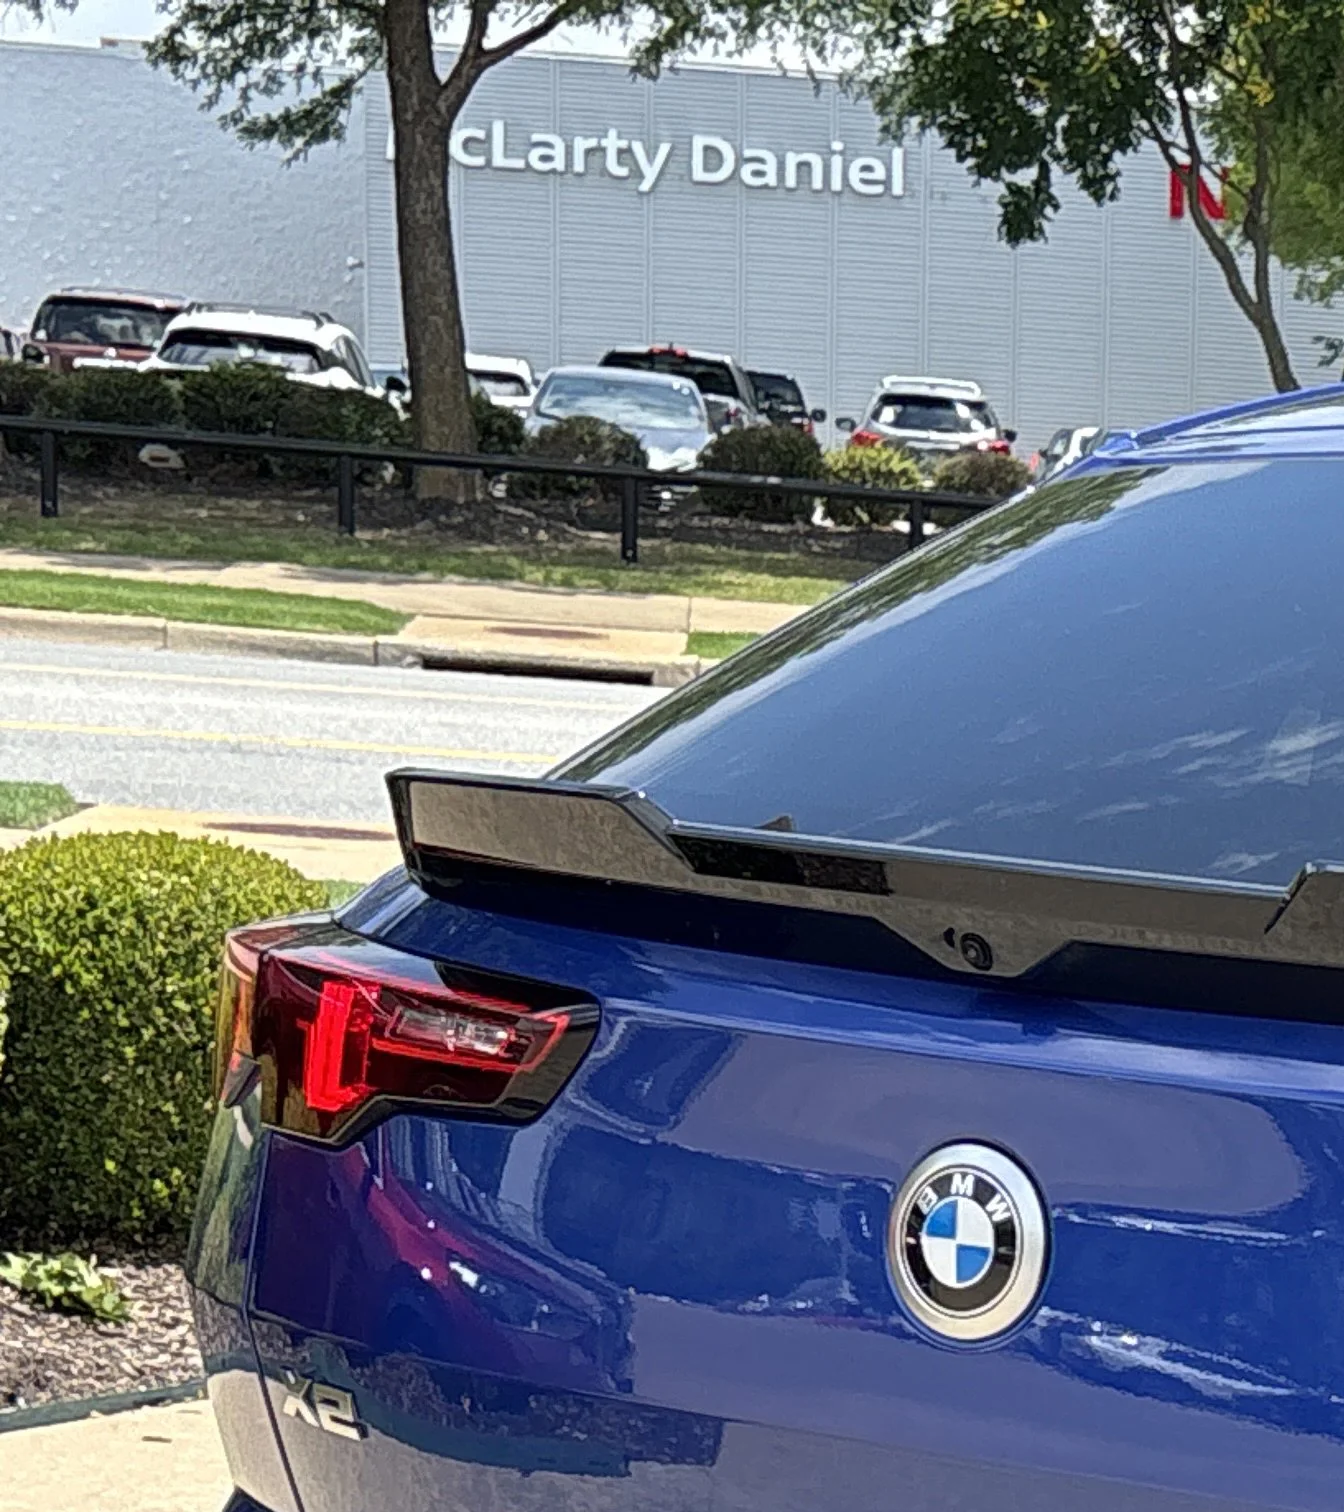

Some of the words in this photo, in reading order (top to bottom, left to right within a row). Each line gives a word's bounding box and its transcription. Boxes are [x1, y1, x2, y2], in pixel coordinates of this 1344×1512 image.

[386, 119, 672, 193] cLarty
[691, 134, 906, 197] Daniel
[916, 1172, 1011, 1223] BMW
